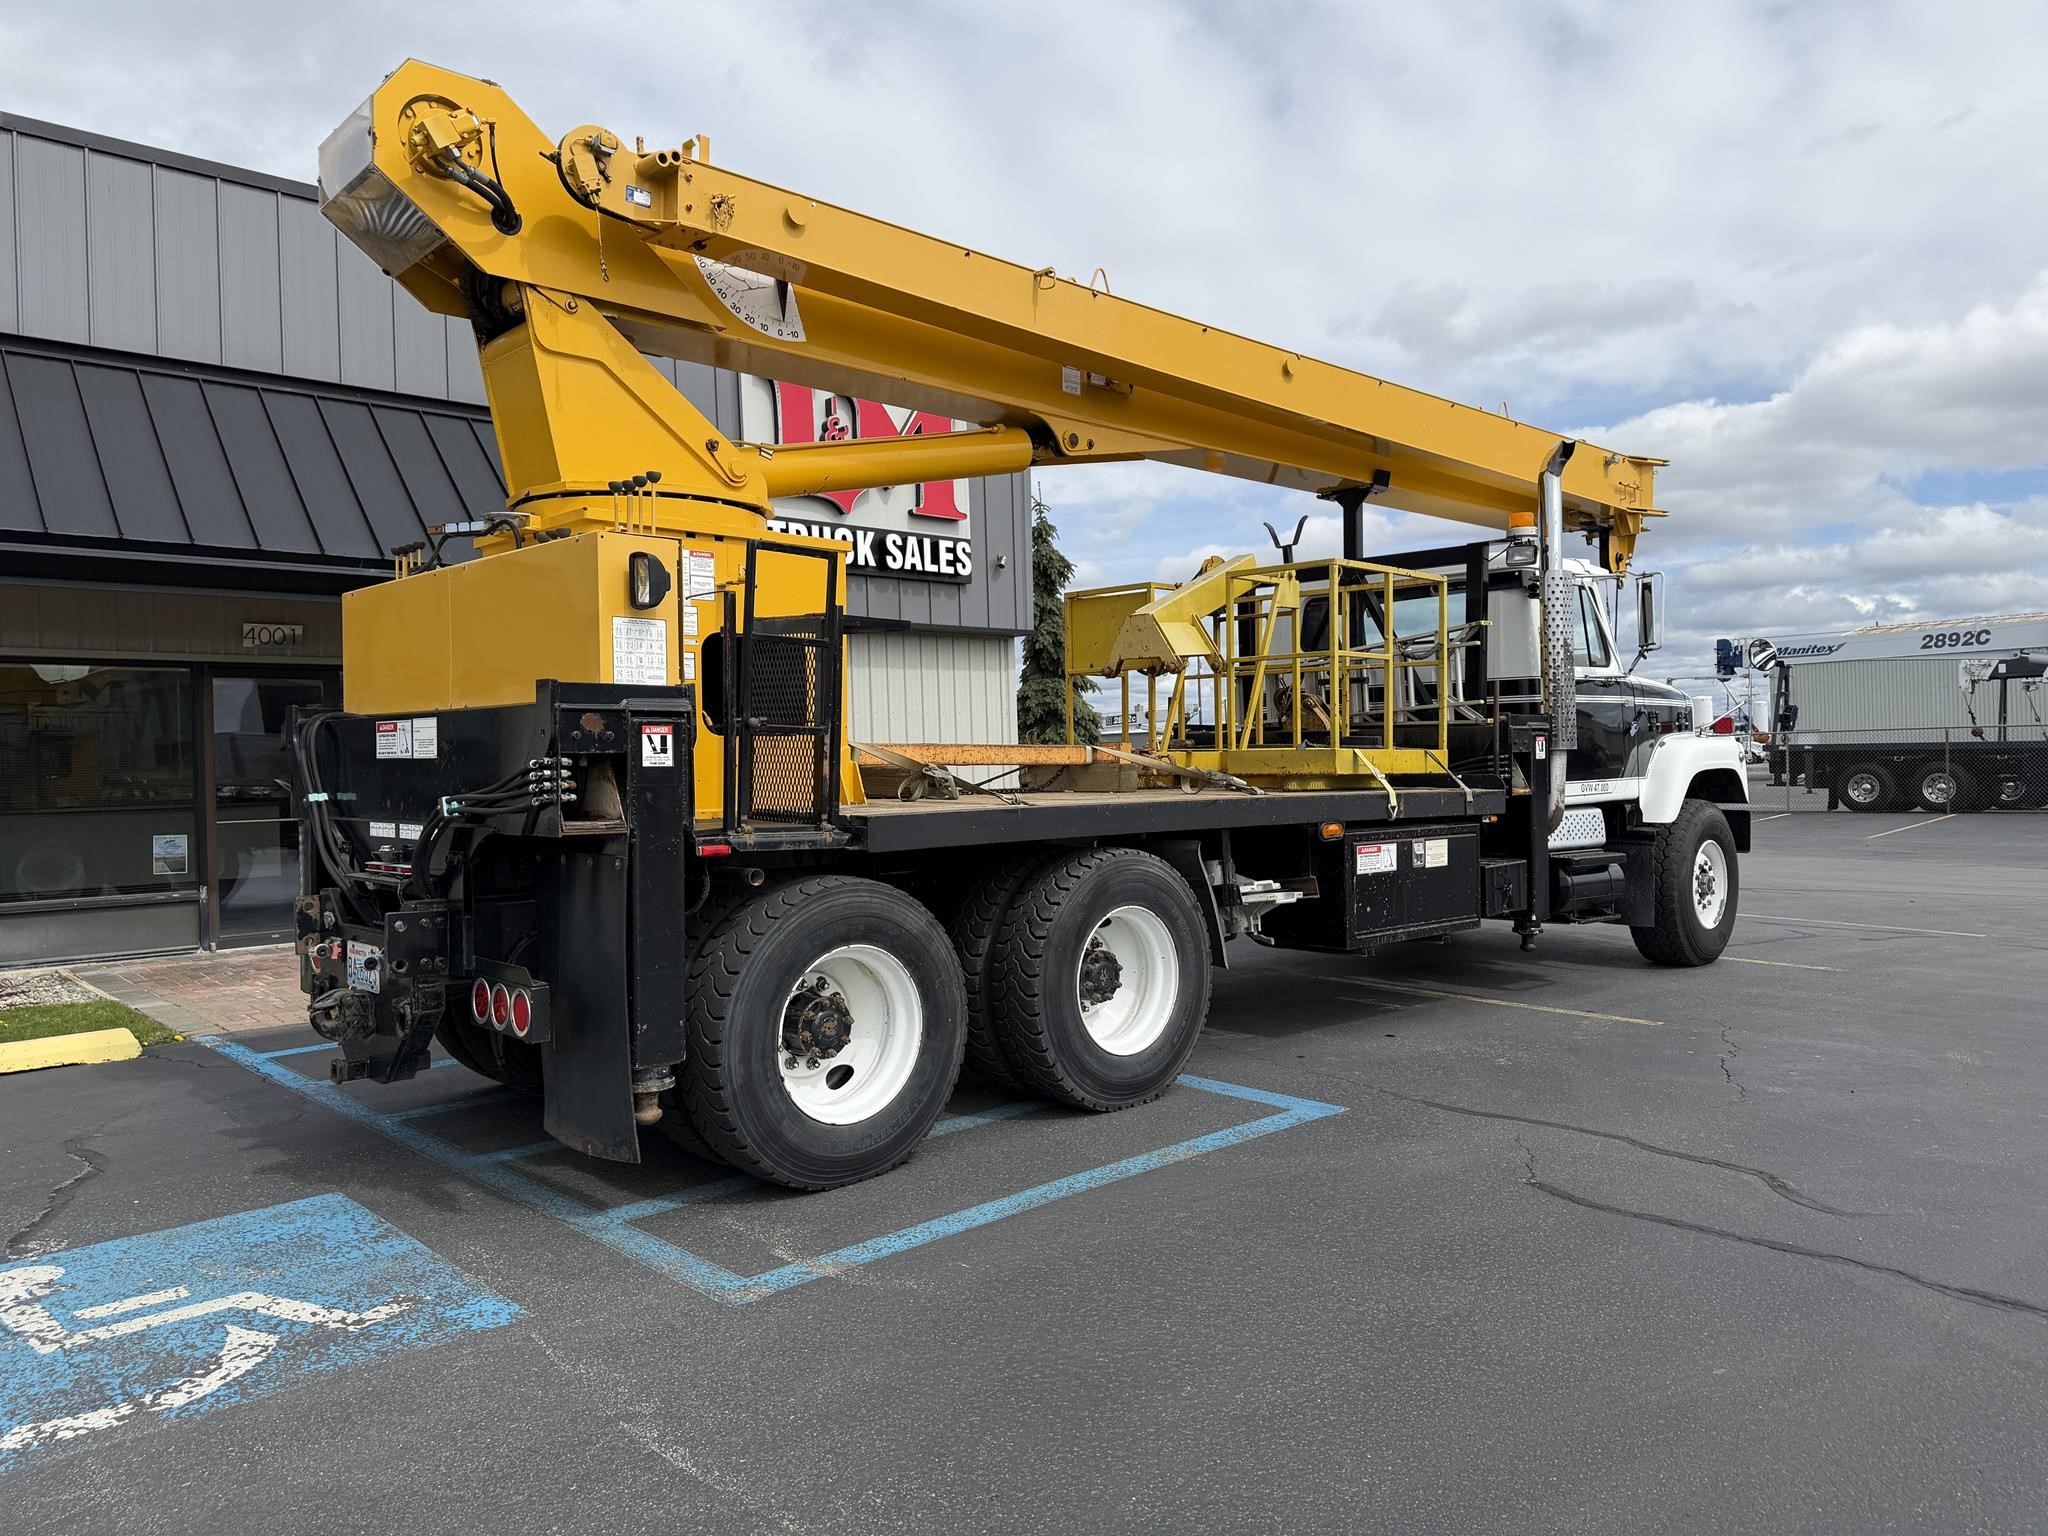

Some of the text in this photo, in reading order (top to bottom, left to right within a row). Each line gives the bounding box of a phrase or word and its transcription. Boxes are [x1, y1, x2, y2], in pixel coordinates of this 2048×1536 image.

[705, 272, 717, 285] 50
[716, 287, 727, 300] 40
[730, 302, 741, 314] 30
[744, 313, 755, 325] 20
[760, 323, 769, 332] 10
[777, 328, 784, 337] 0
[786, 331, 799, 339] -10
[885, 533, 972, 576] SALES
[243, 626, 296, 646] 4001
[1920, 629, 1991, 649] 2892C
[1776, 643, 1836, 657] Manitex
